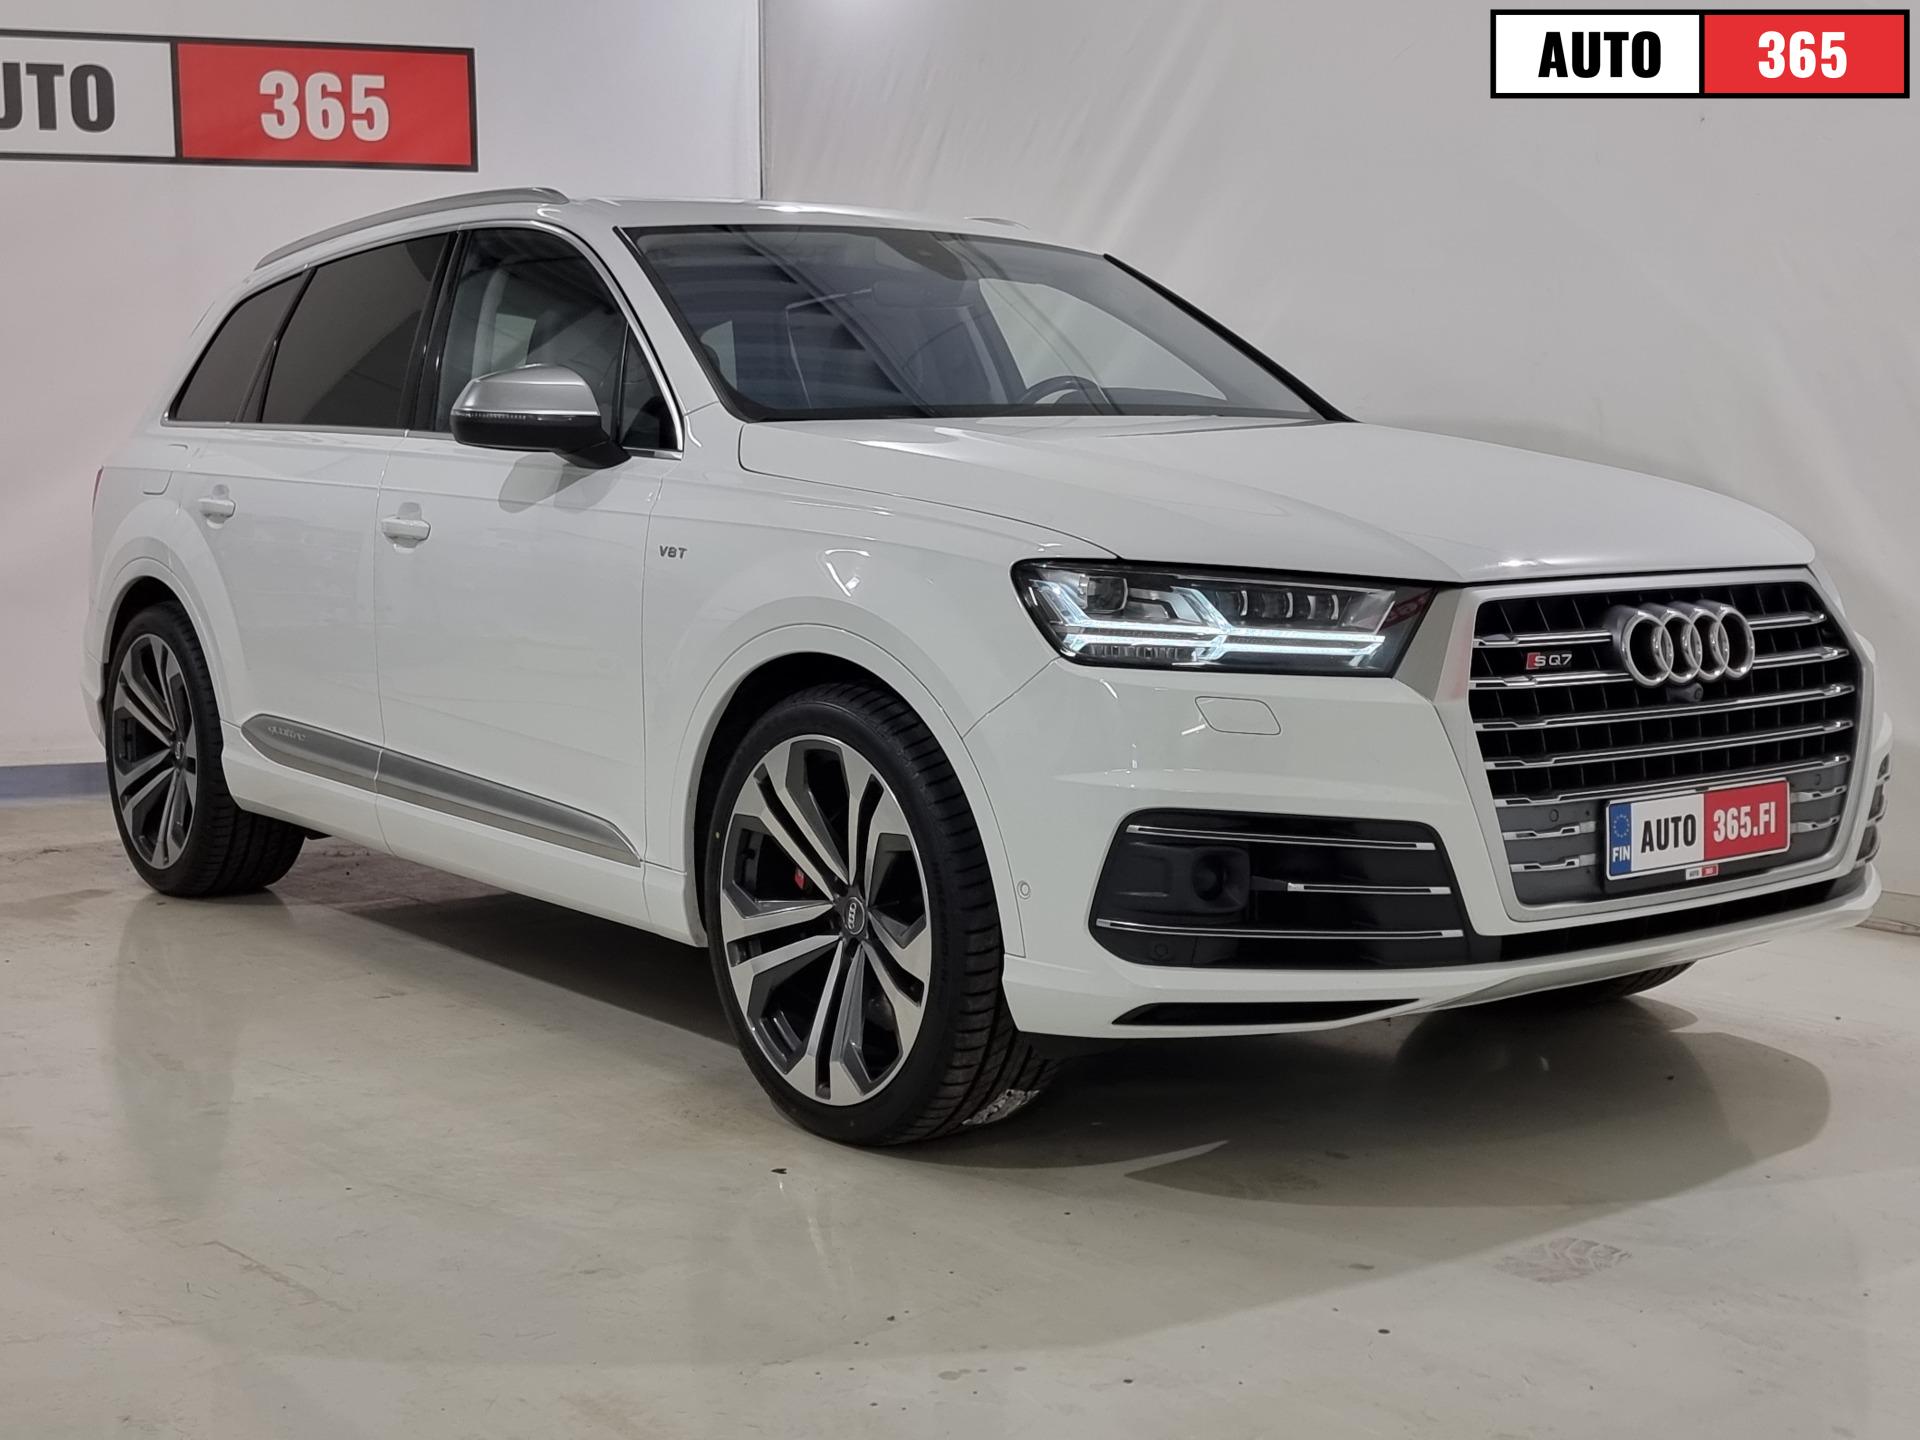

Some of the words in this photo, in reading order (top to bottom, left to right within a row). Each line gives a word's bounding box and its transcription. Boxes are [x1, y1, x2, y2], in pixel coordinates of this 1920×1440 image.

[259, 70, 390, 141] 365
[660, 545, 688, 559] V8T
[1612, 845, 1631, 863] FIN
[1641, 814, 1696, 853] AUTO
[1713, 802, 1776, 842] 365.FI
